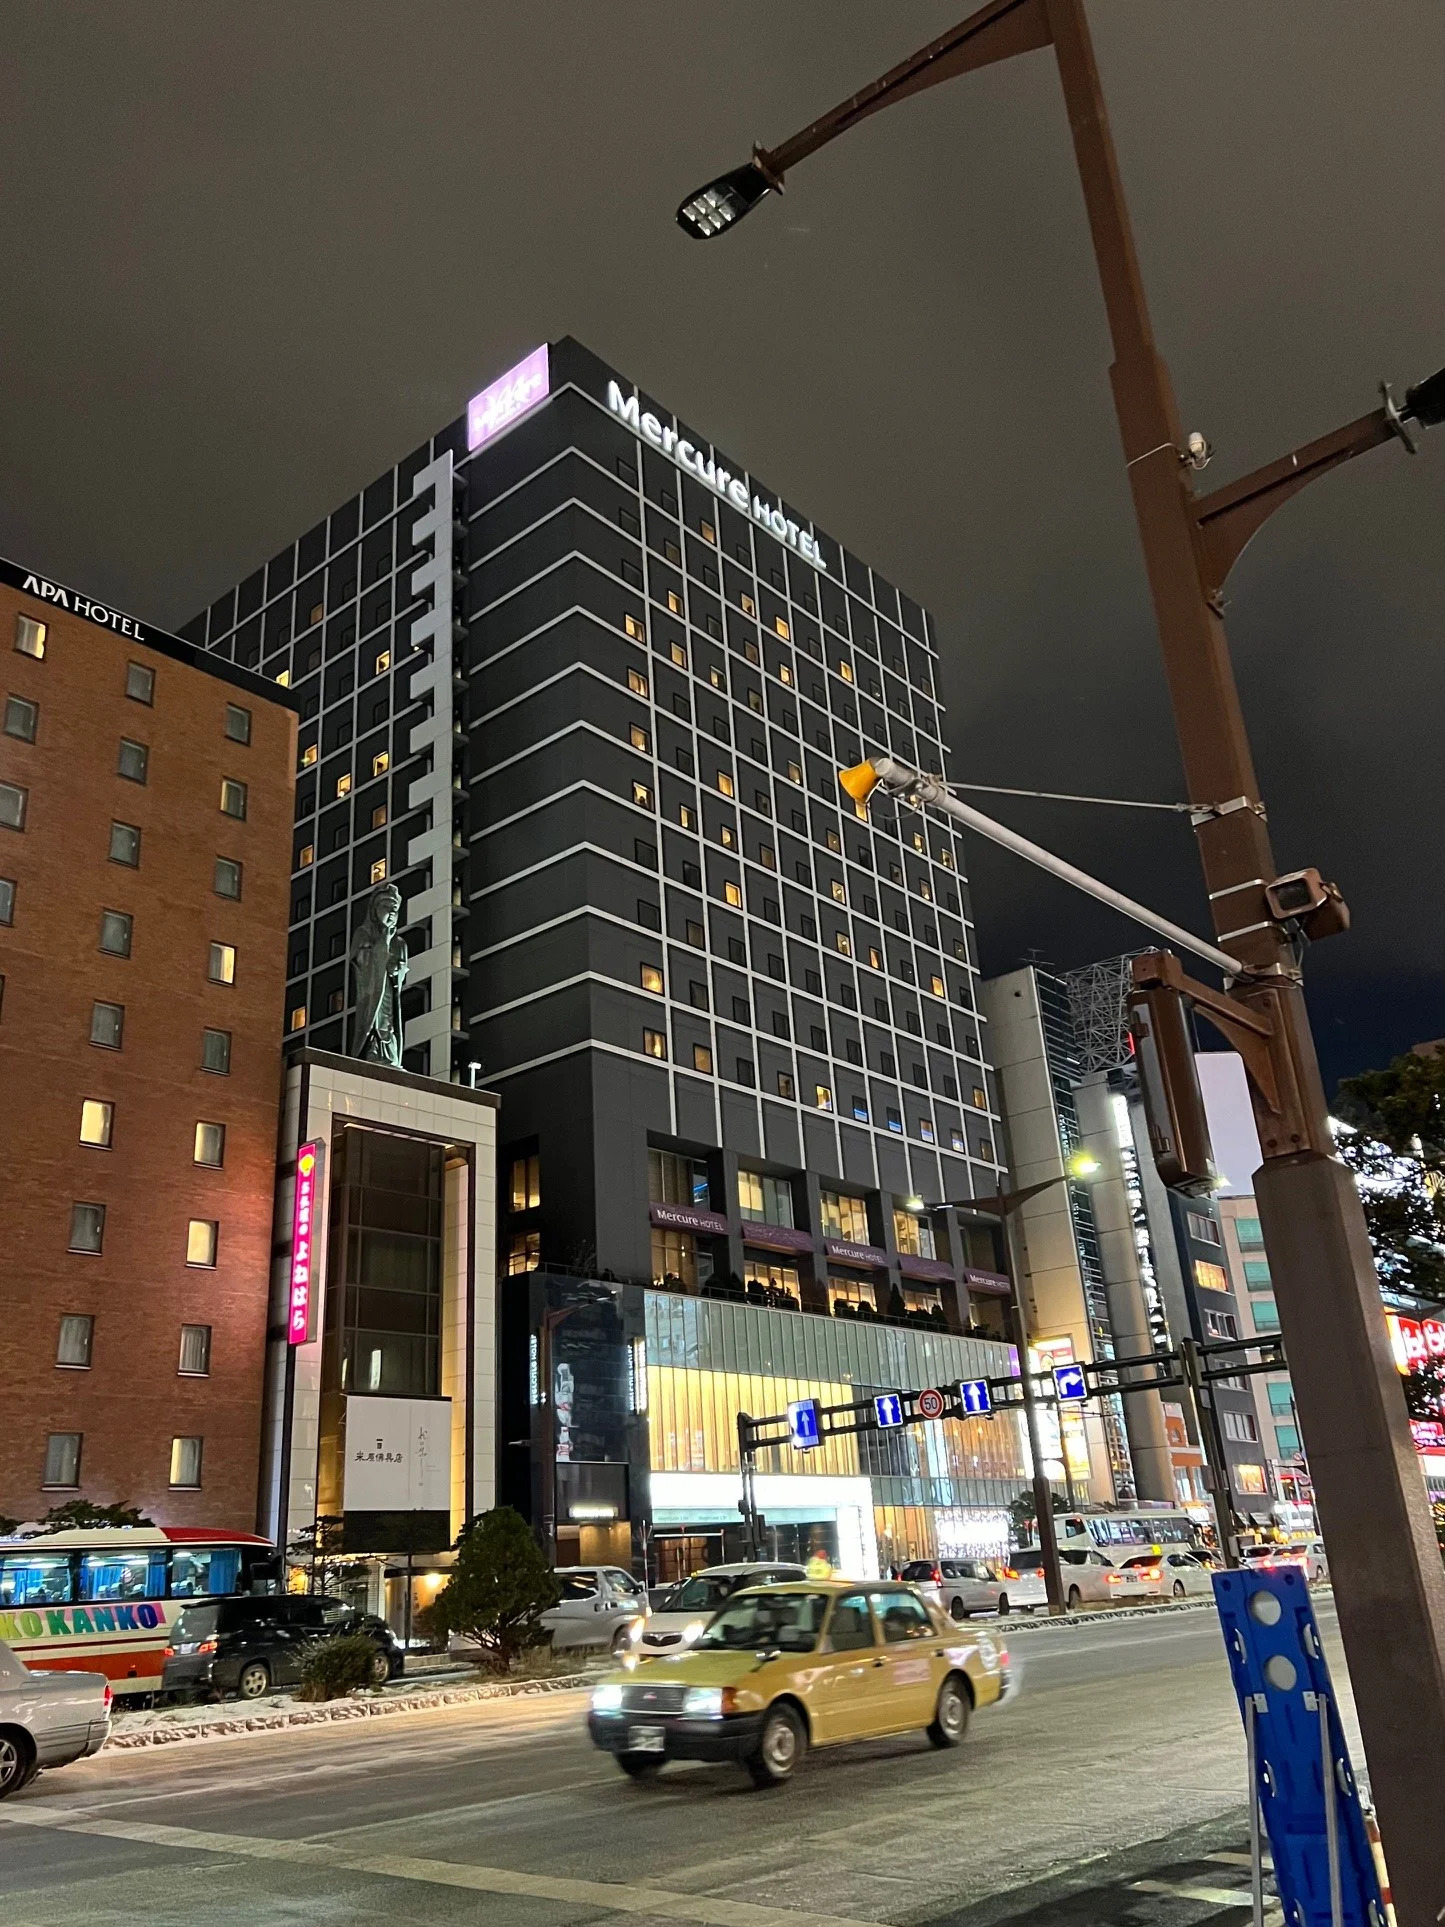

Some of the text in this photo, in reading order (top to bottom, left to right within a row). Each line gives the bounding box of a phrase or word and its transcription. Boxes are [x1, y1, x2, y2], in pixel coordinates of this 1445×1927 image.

[608, 380, 749, 508] Mercure
[753, 495, 827, 569] HOTEL
[22, 574, 145, 641] APA HOTEL
[656, 1209, 724, 1231] Mercure HOTEL
[831, 1244, 865, 1260] Mercure
[924, 1396, 938, 1411] 50
[45, 1604, 159, 1636] KANKO
